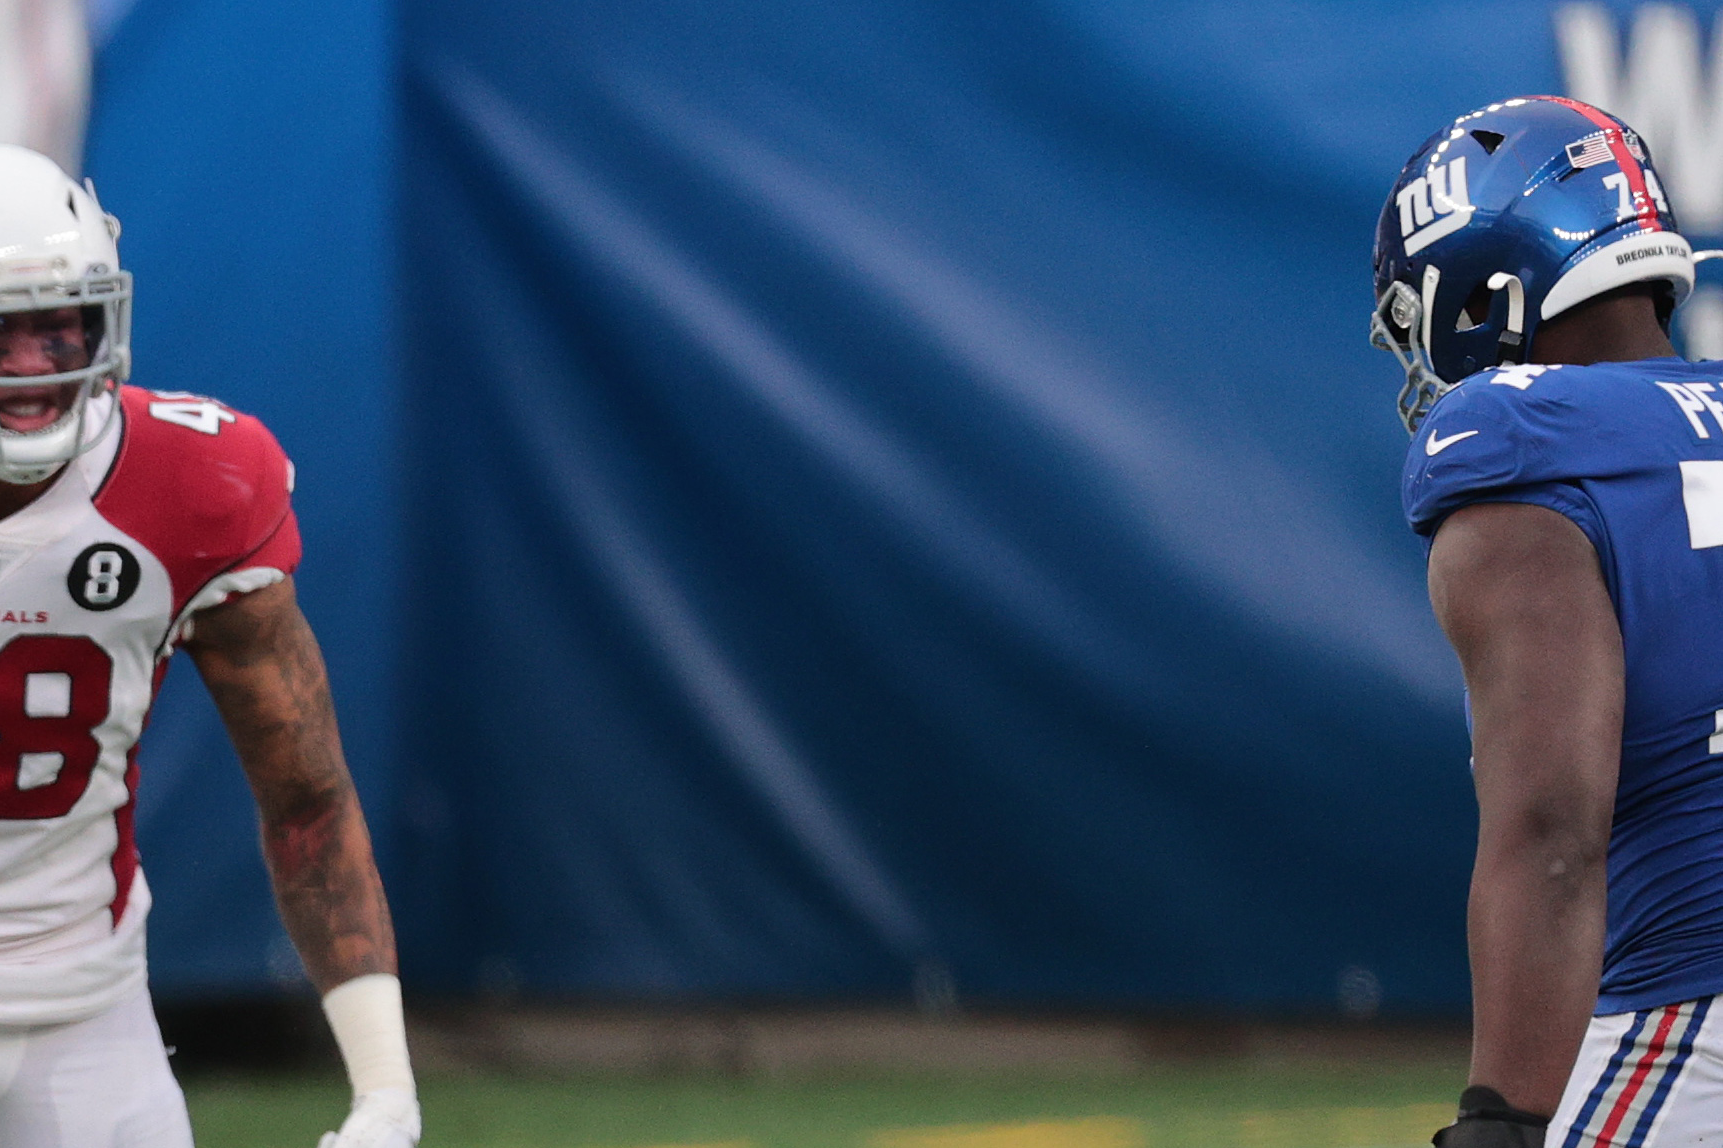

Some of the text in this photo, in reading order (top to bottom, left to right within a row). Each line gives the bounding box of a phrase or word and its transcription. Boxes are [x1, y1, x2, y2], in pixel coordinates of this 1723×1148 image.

[1602, 168, 1669, 219] 74
[1615, 246, 1664, 266] BREONNA
[1655, 381, 1723, 440] PE
[84, 550, 124, 604] 8
